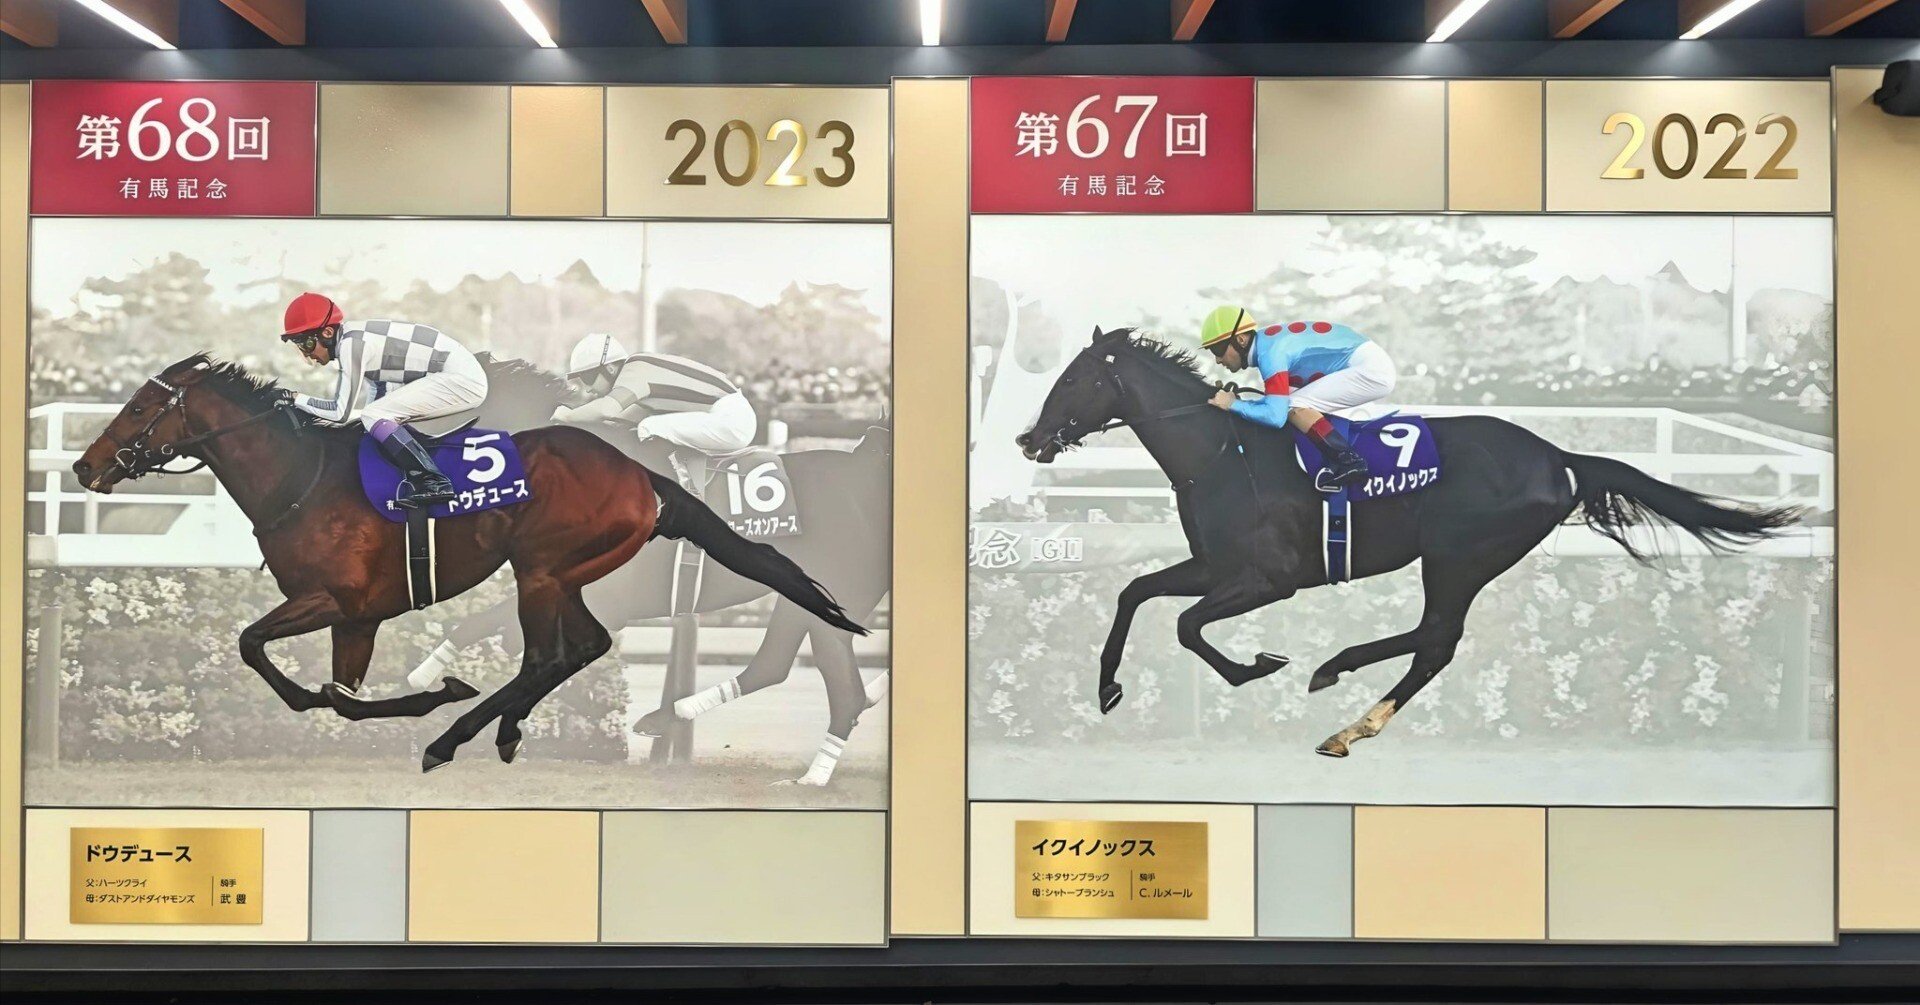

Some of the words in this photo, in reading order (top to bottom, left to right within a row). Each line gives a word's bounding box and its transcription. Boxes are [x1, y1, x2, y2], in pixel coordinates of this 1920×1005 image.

[75, 97, 271, 162] 第68回
[1014, 94, 1209, 159] 第67回
[1600, 112, 1799, 180] 2022
[663, 118, 855, 187] 2023
[119, 177, 228, 199] 有馬記念
[1057, 174, 1166, 196] 有馬記念
[462, 433, 506, 483] 5
[1379, 422, 1421, 468] 9
[726, 461, 786, 515] 16
[1363, 467, 1438, 497] イクイノックス
[86, 844, 192, 863] ドウデュース
[1032, 838, 1156, 857] イクイノックス
